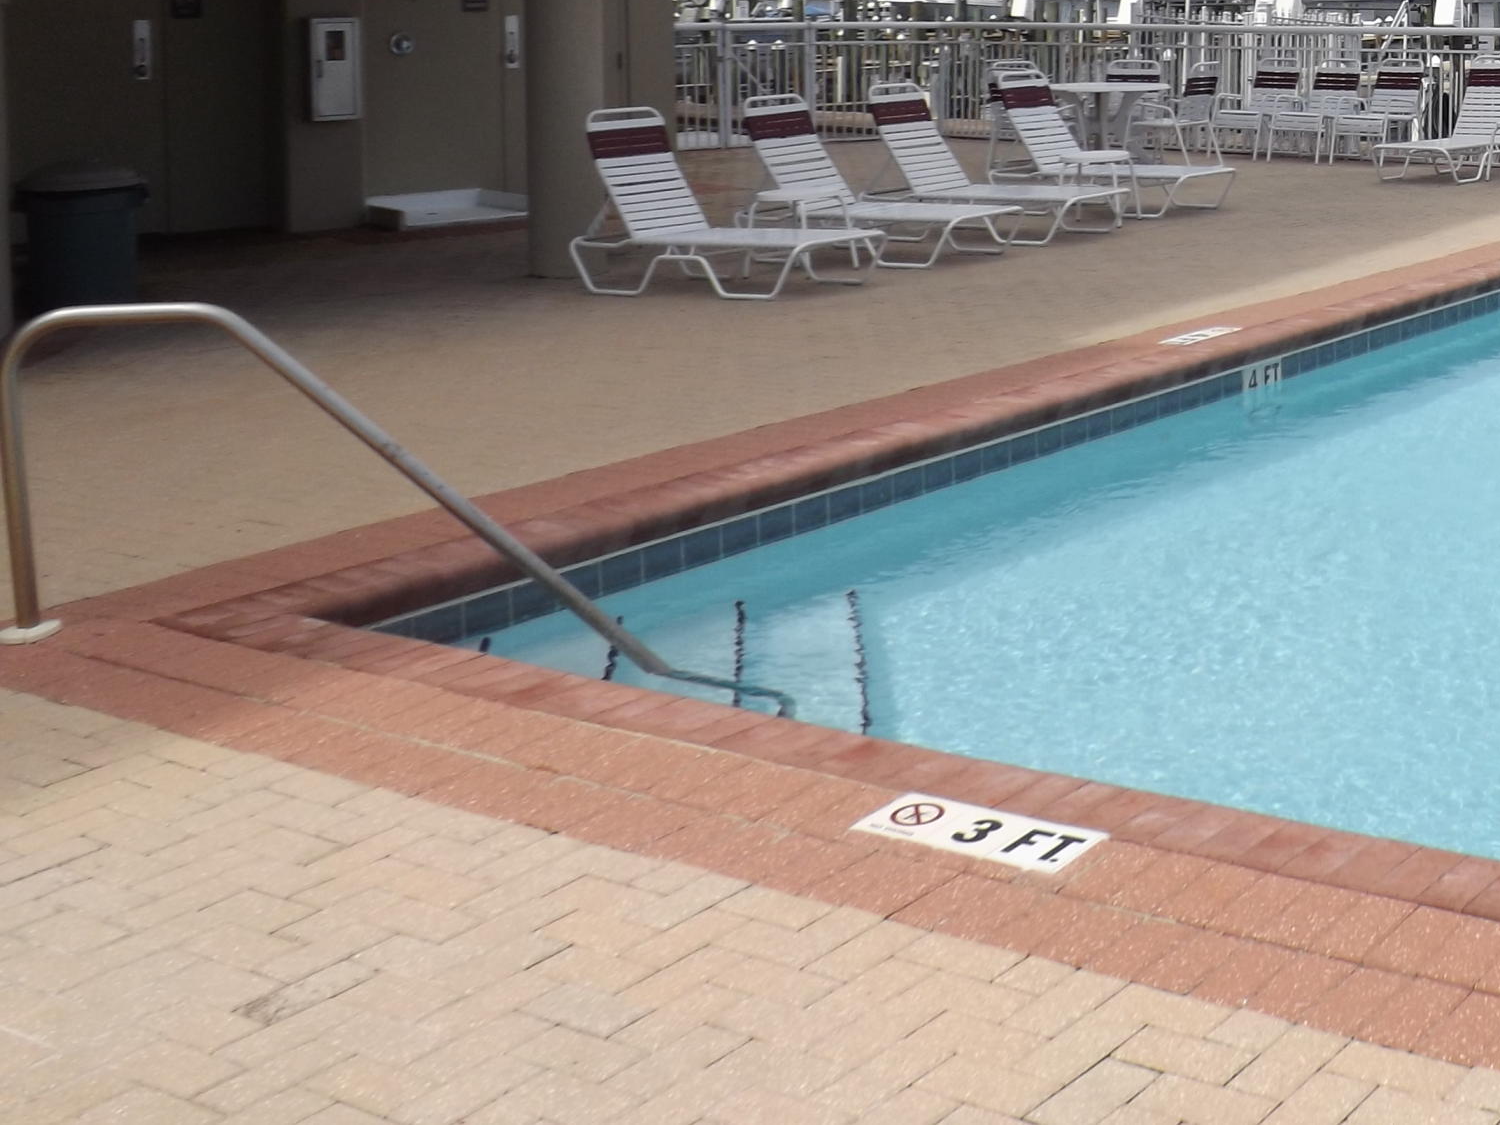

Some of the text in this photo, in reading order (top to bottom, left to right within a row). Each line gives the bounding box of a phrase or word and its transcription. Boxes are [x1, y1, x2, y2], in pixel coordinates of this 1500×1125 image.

[1248, 363, 1280, 388] 4 FT
[951, 819, 1086, 862] 3 FT.
